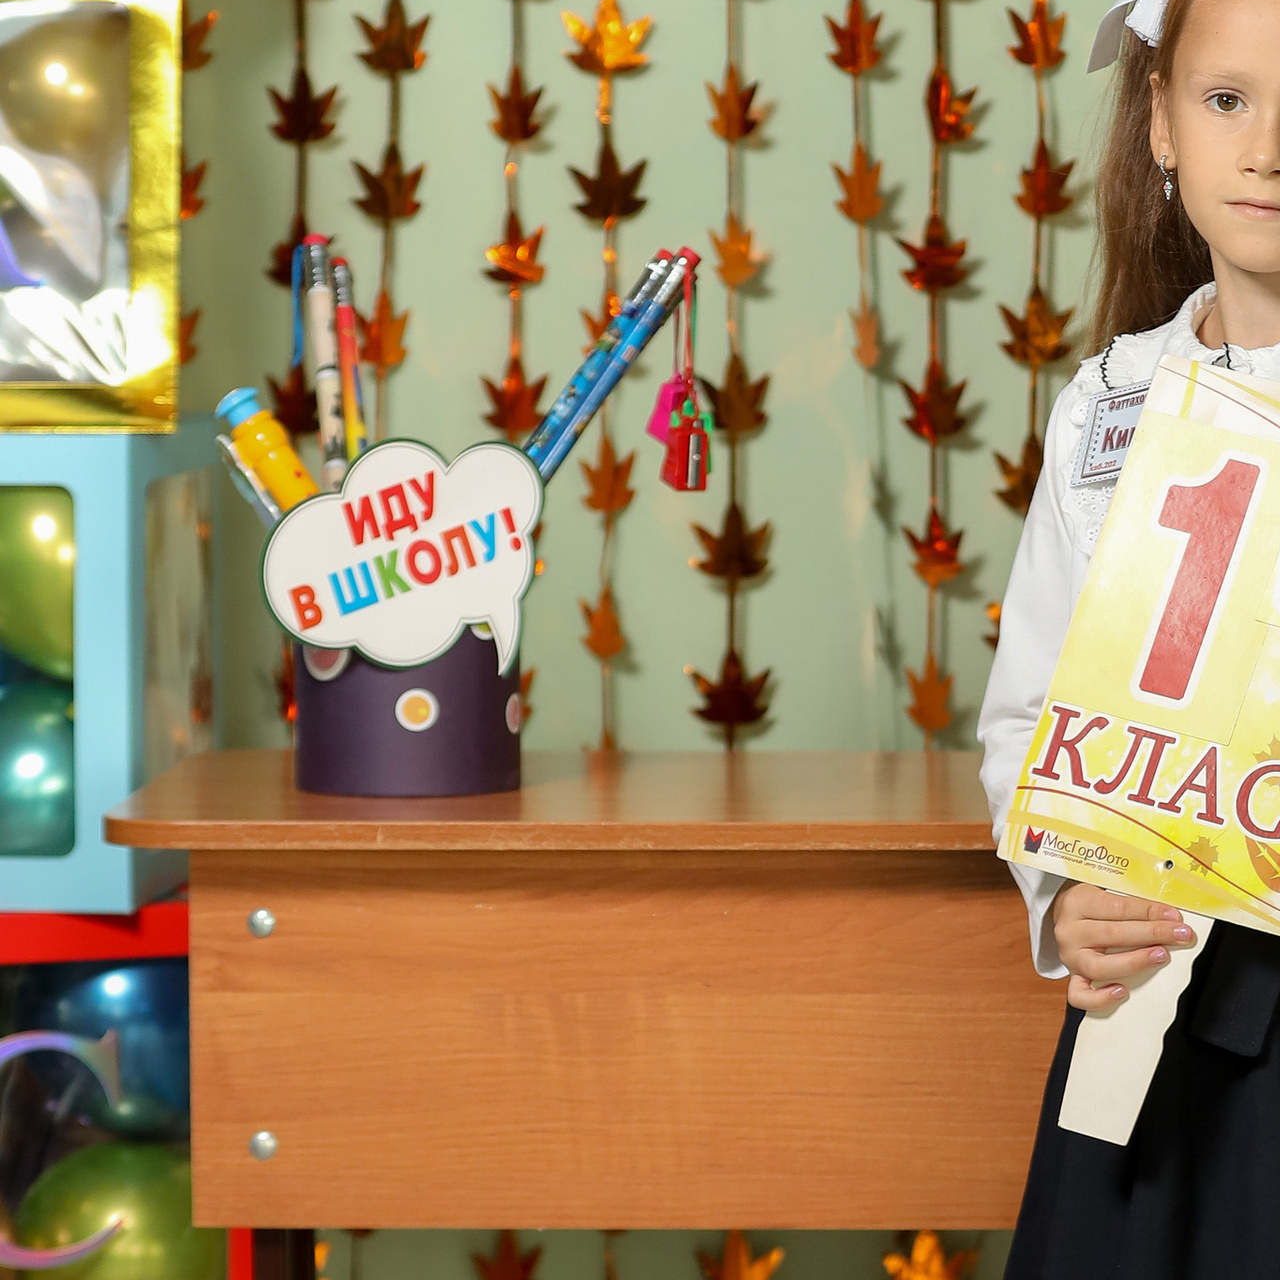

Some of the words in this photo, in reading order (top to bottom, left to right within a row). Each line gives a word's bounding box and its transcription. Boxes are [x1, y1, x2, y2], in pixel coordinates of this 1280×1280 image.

[1108, 393, 1147, 412] Фаттахо
[341, 471, 436, 546] ИДУ
[288, 584, 323, 631] В
[327, 507, 522, 616] ШКОЛУ!
[1139, 458, 1261, 701] 1
[1043, 832, 1130, 868] МосГорФото
